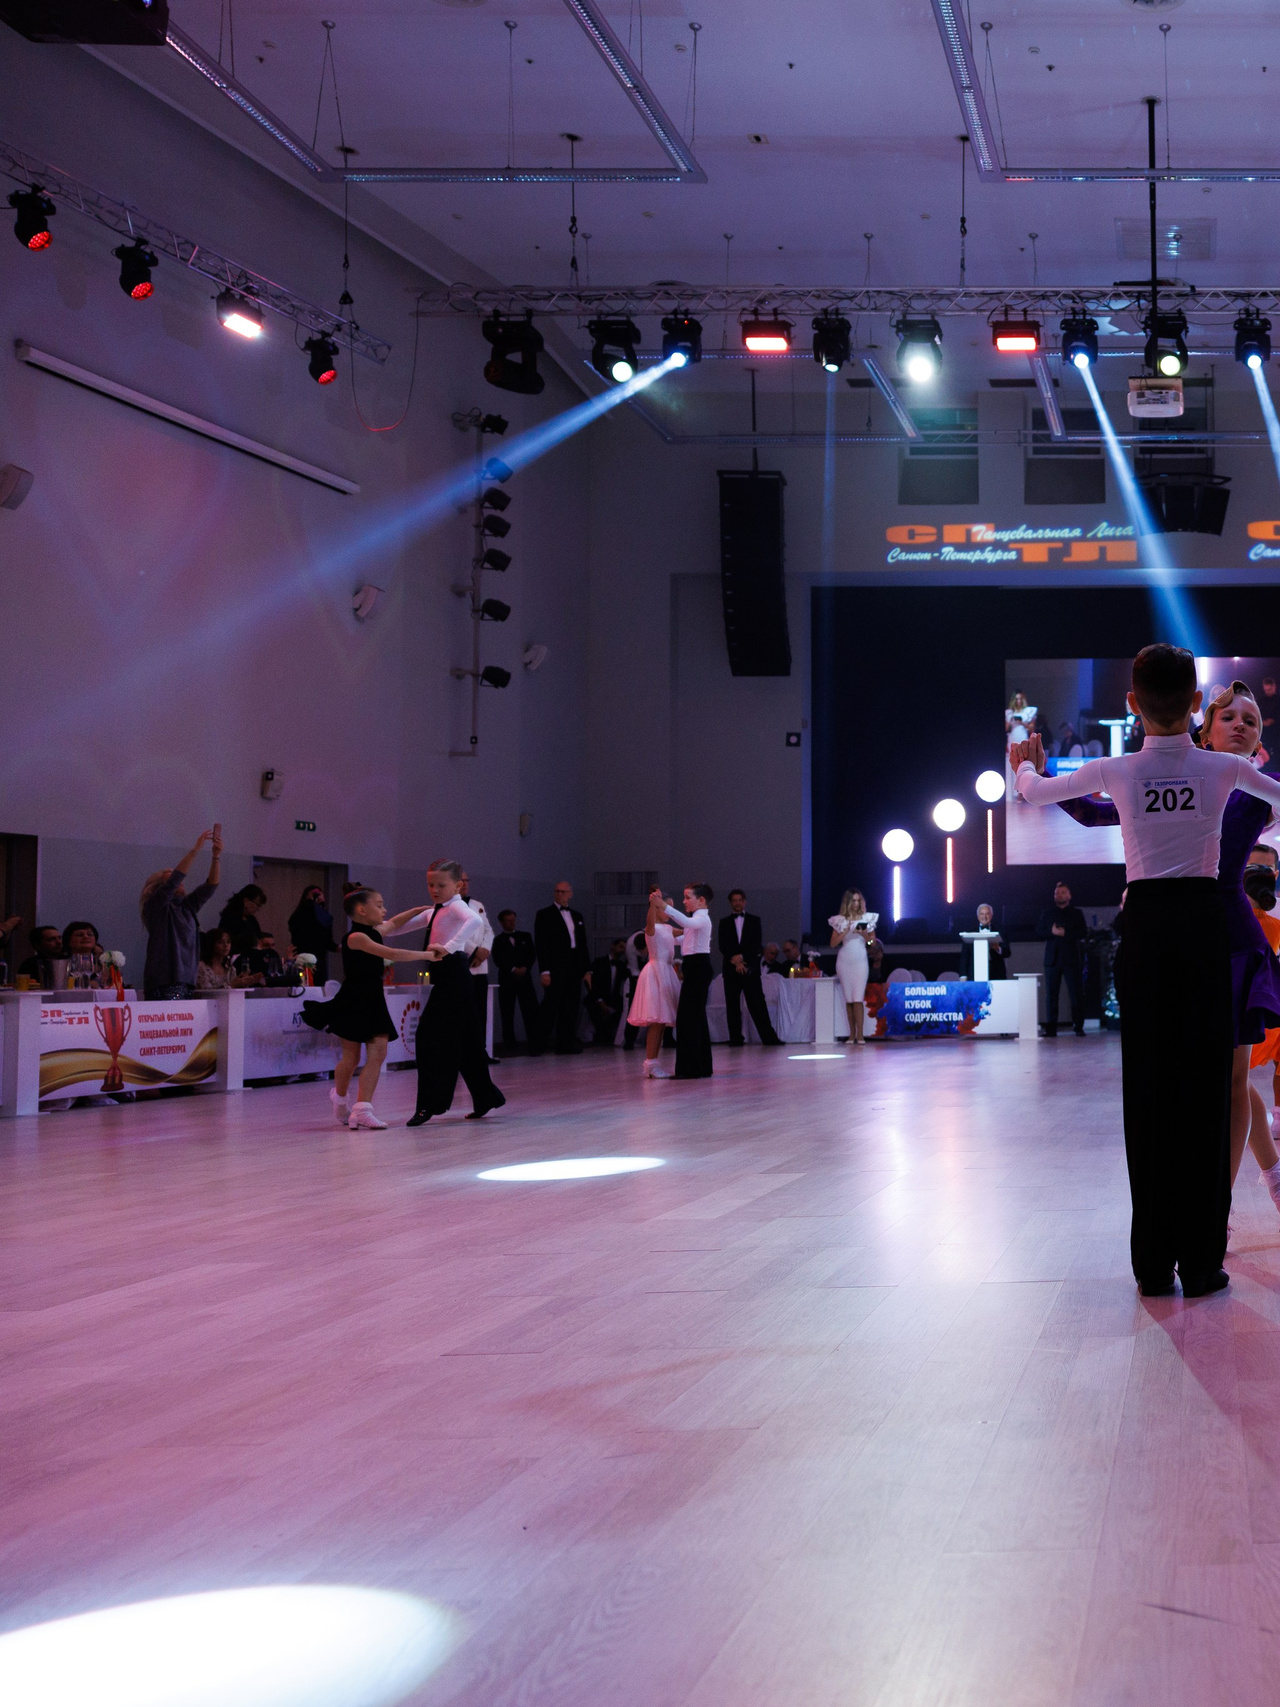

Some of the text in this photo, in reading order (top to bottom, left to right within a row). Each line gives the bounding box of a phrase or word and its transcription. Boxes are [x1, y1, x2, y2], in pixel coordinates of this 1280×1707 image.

[885, 520, 1135, 545] СП Танцевальная Лига
[886, 540, 1138, 564] Санкт-Петербурга ТЛ
[1144, 787, 1196, 813] 202
[905, 985, 946, 995] БОЛЬШОЙ
[905, 1000, 931, 1008] КУБОК
[138, 1012, 194, 1023] ОТКРЫТЫЙ ФЕСТИВАЛЬ
[905, 1012, 963, 1022] СОДРУЖЕСТВА
[139, 1027, 193, 1041] ТАНЦЕВАЛЬНОЙ ЛИГИ
[139, 1045, 187, 1057] САНКТ-ПЕТЕРБУРГА
